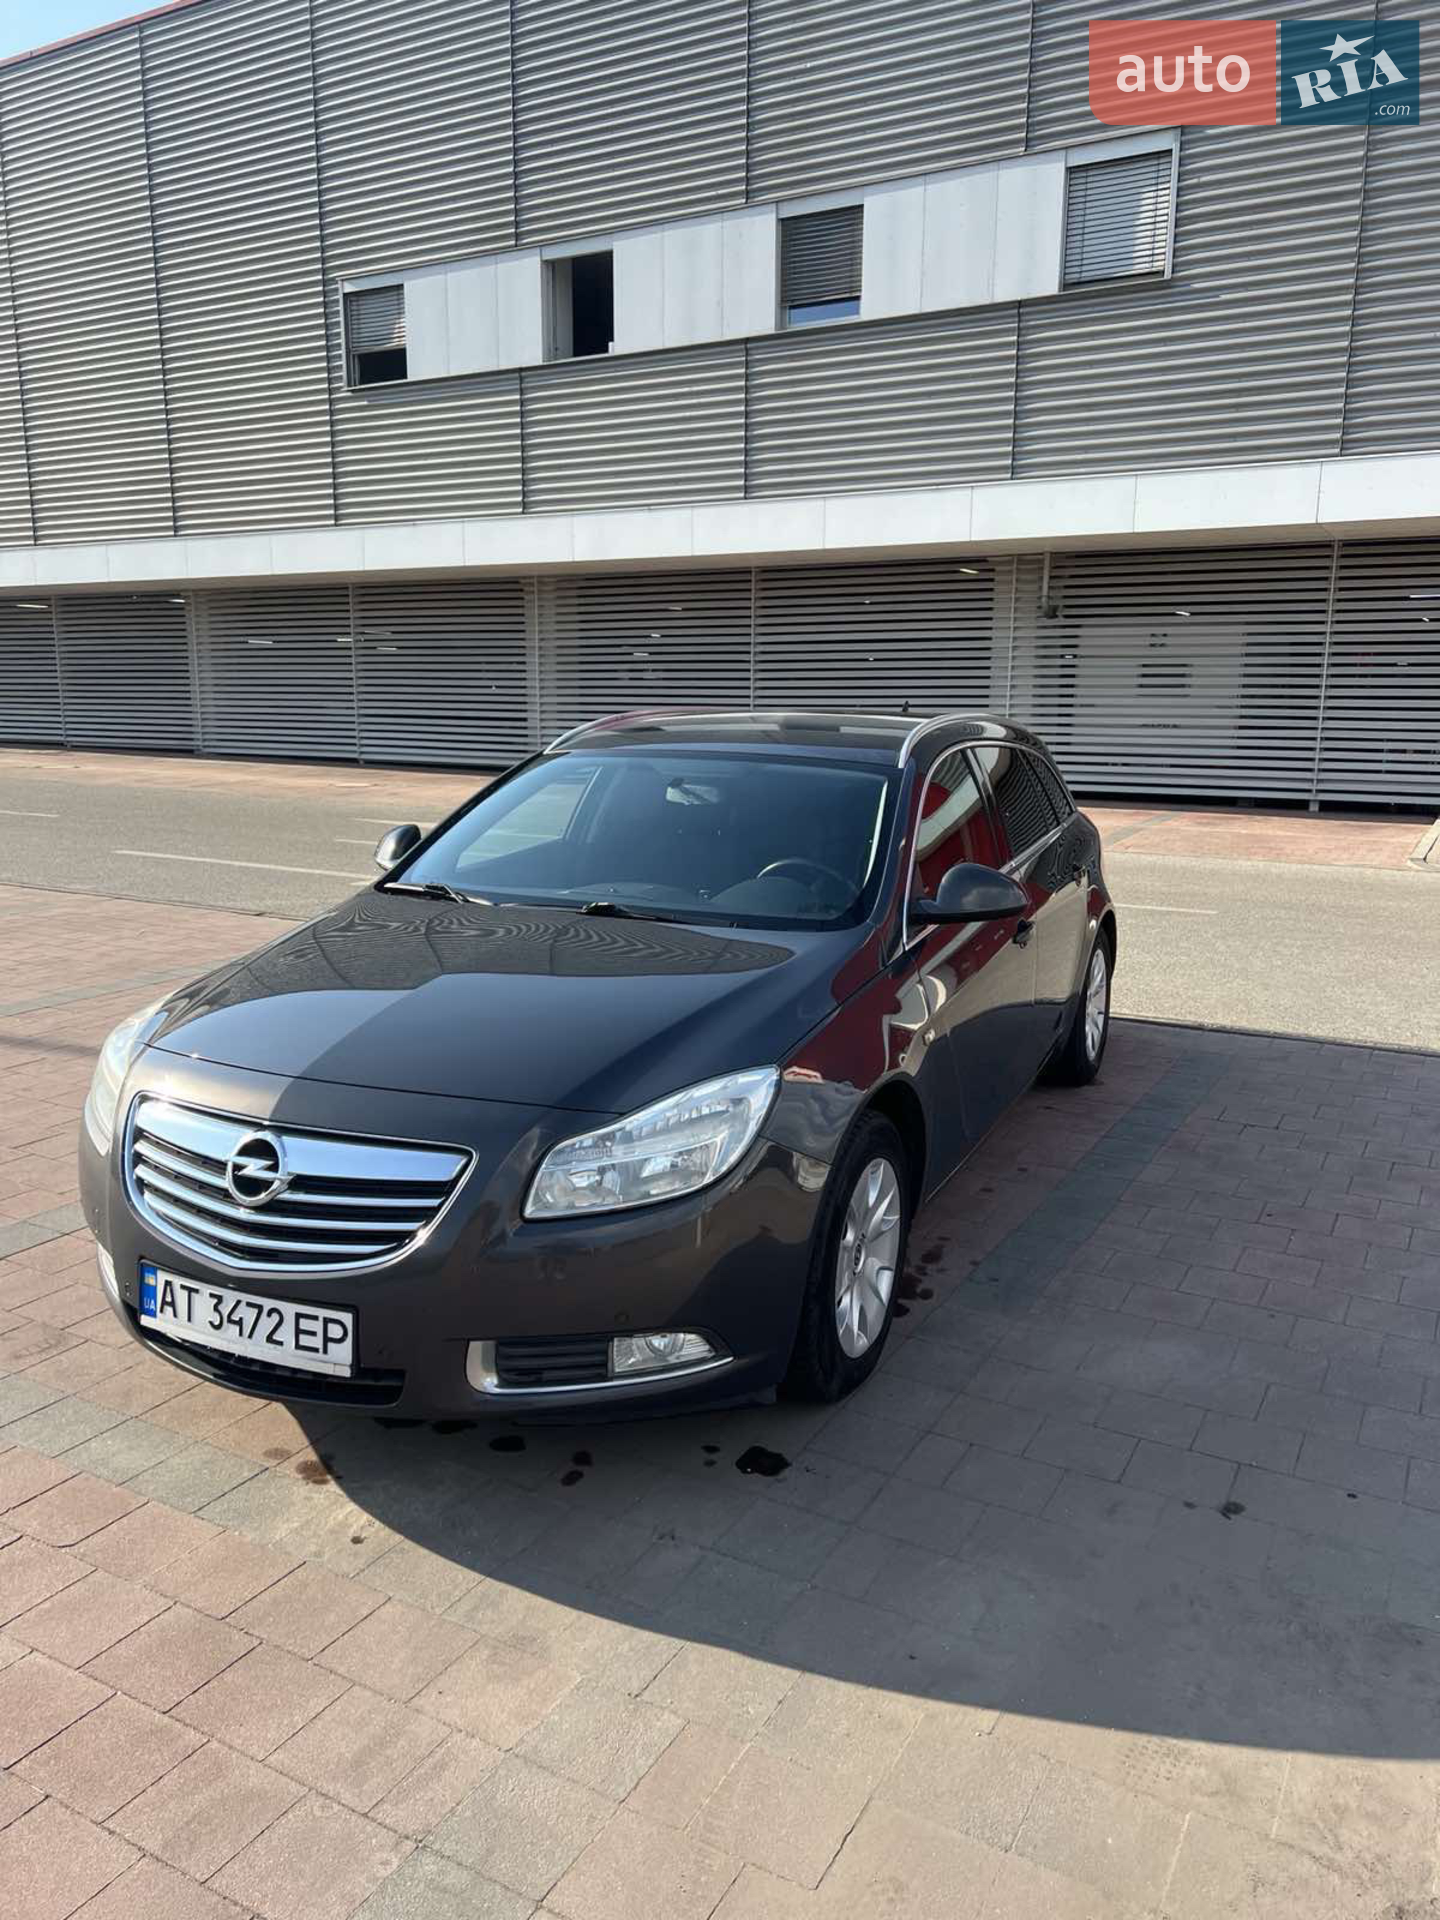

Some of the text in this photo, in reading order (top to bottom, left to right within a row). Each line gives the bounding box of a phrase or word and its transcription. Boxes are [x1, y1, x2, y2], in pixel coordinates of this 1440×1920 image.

[144, 1297, 156, 1311] UA
[159, 1280, 349, 1355] AT 3472 EP
